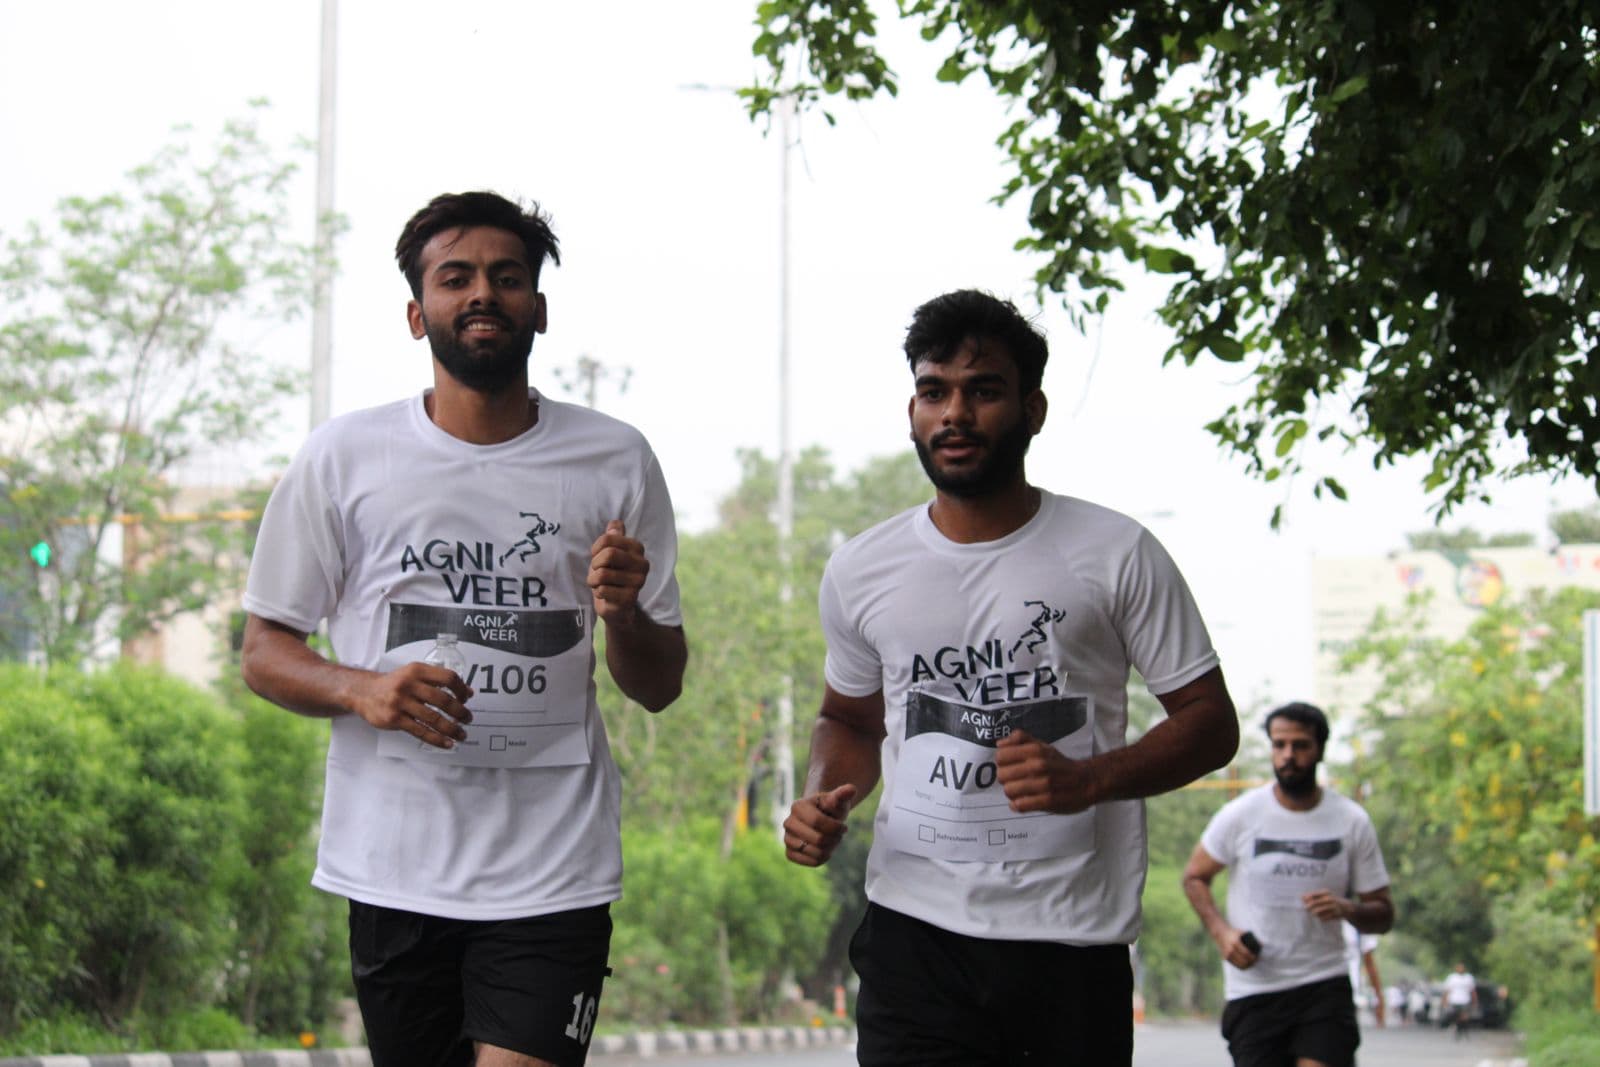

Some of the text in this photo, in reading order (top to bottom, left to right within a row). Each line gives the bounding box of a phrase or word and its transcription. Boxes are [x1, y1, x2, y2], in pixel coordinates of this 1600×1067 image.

[401, 539, 494, 573] AGNI
[441, 573, 548, 607] VEER
[463, 614, 502, 629] AGNI
[479, 628, 518, 642] VEER
[911, 639, 1004, 683] AGNI
[465, 663, 547, 695] 106
[953, 666, 1059, 705] VEER
[960, 710, 996, 727] AGNI
[975, 725, 1012, 740] VEER
[565, 992, 596, 1046] 16
